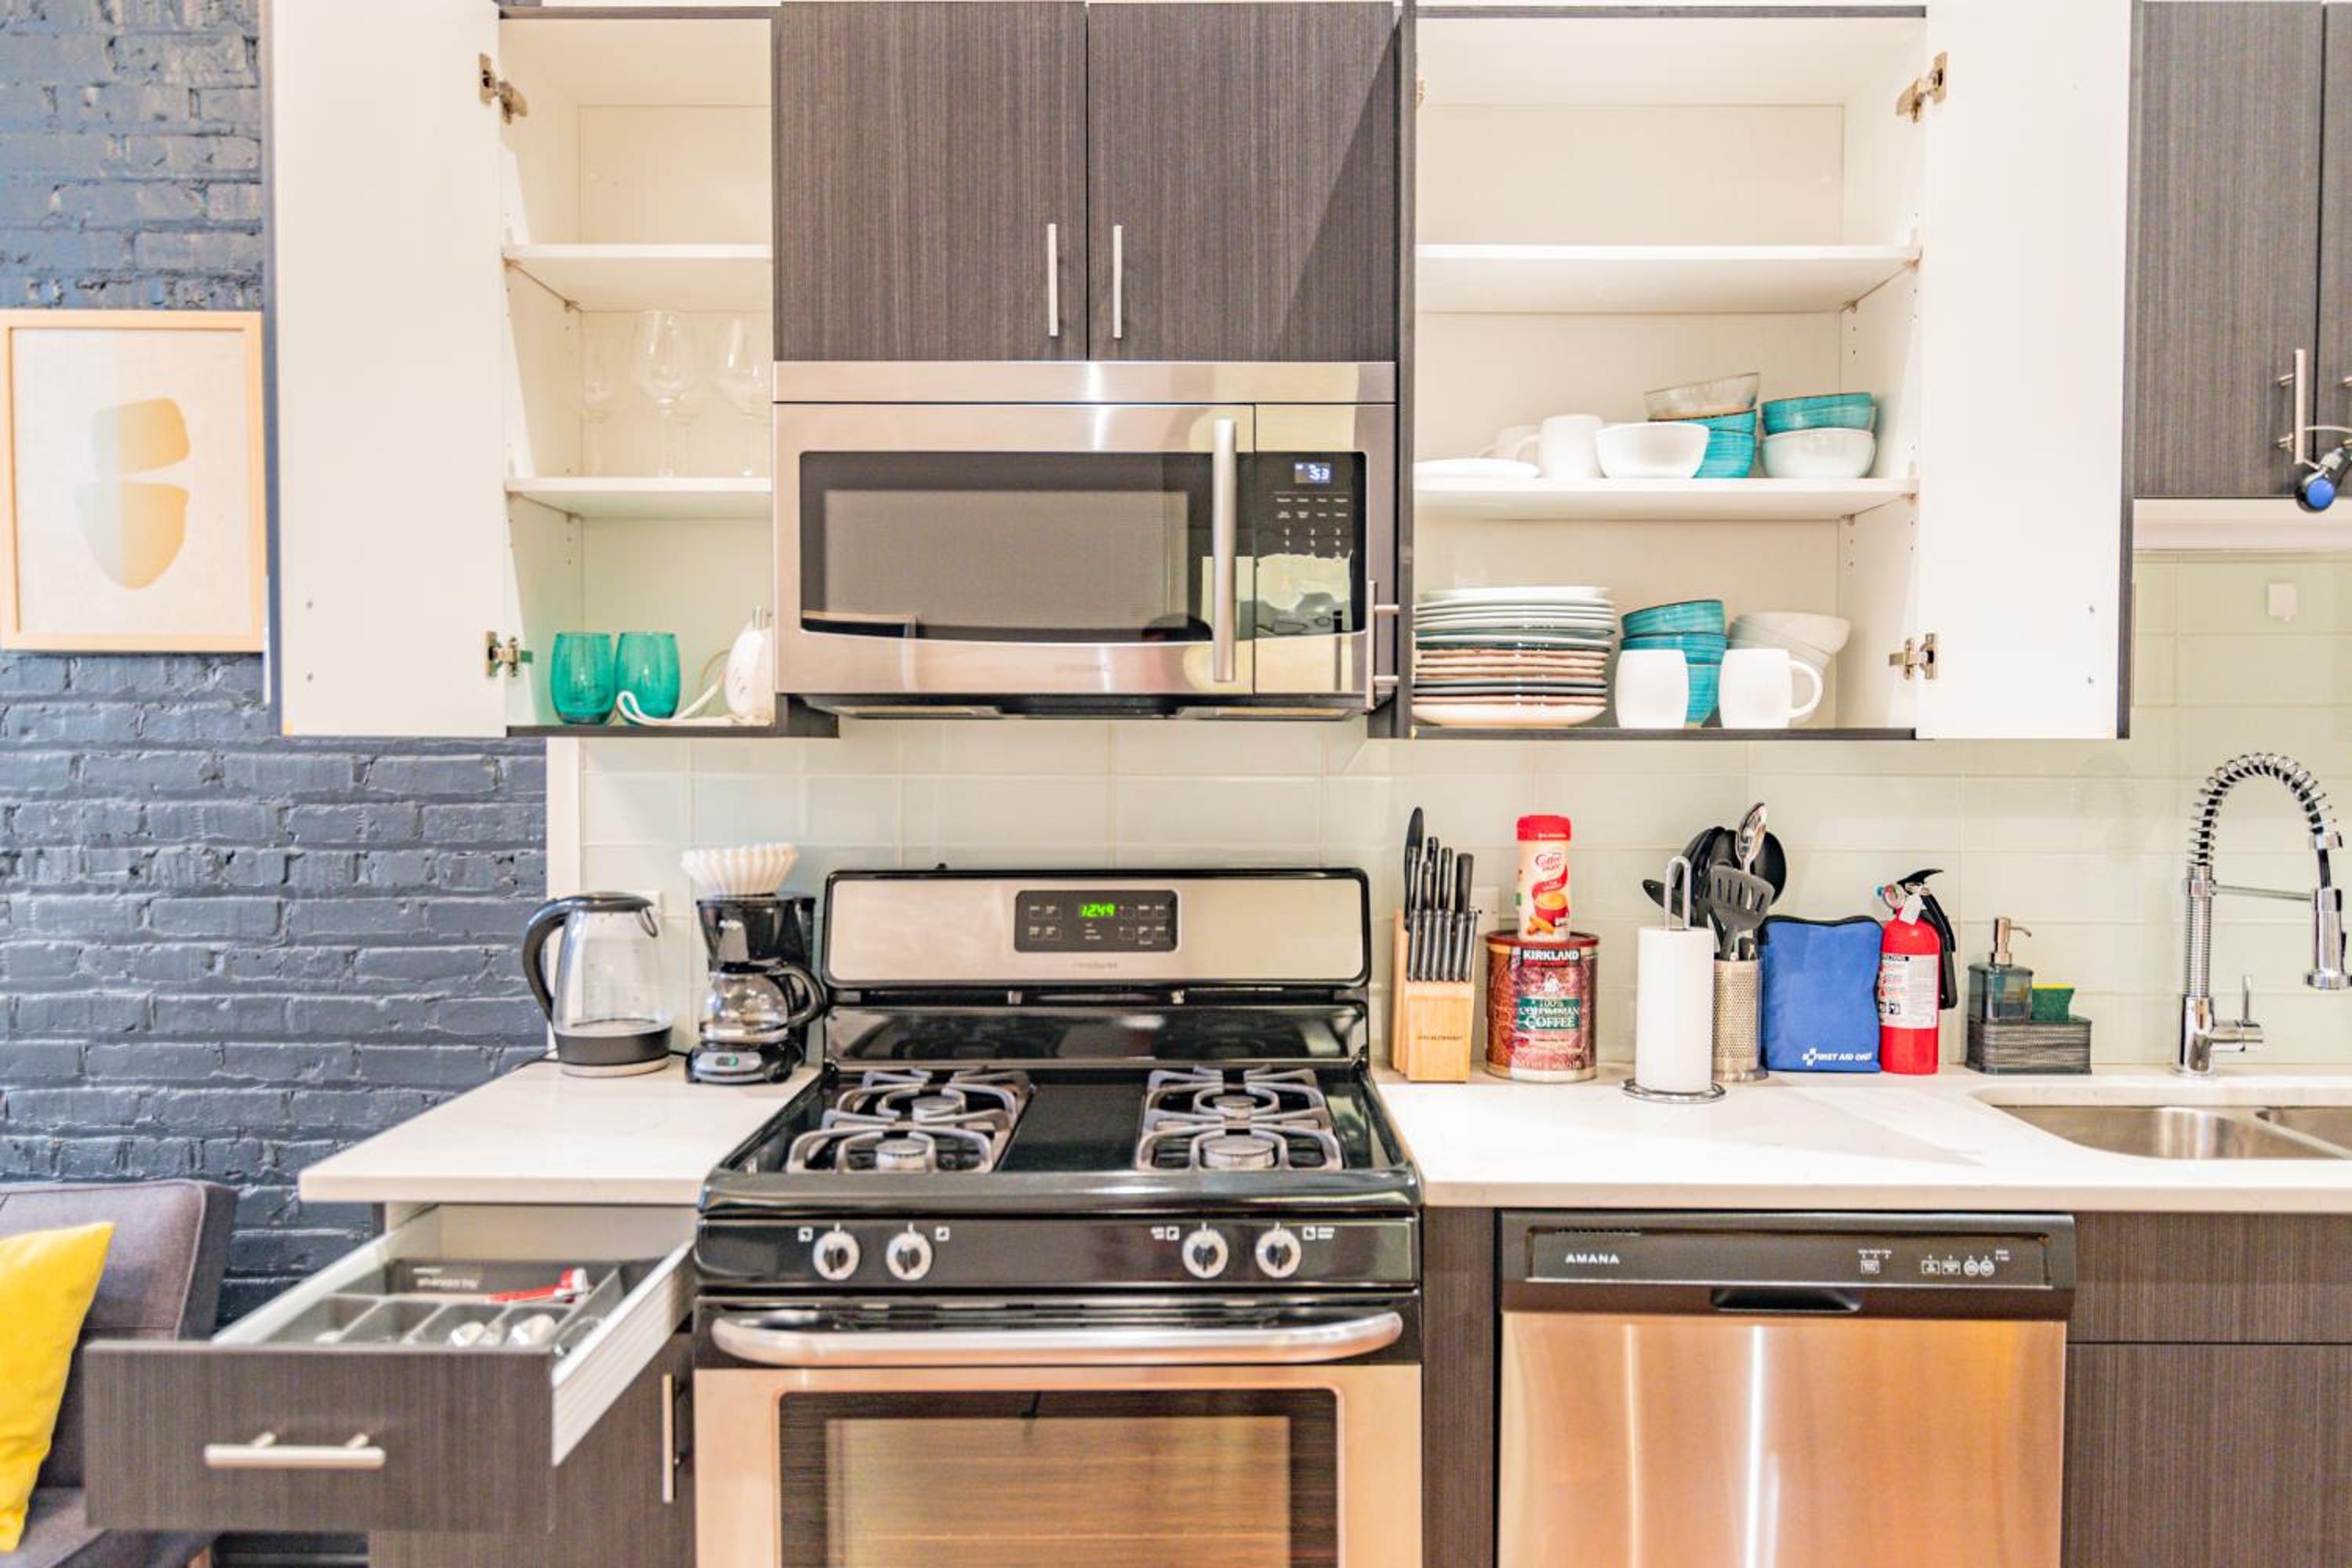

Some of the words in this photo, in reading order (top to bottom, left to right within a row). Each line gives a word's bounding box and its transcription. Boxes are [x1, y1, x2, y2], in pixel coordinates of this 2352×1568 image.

[1523, 949, 1580, 961] KIRKLAND
[1525, 1015, 1575, 1028] COFFEE
[1565, 1253, 1620, 1265] AMANA
